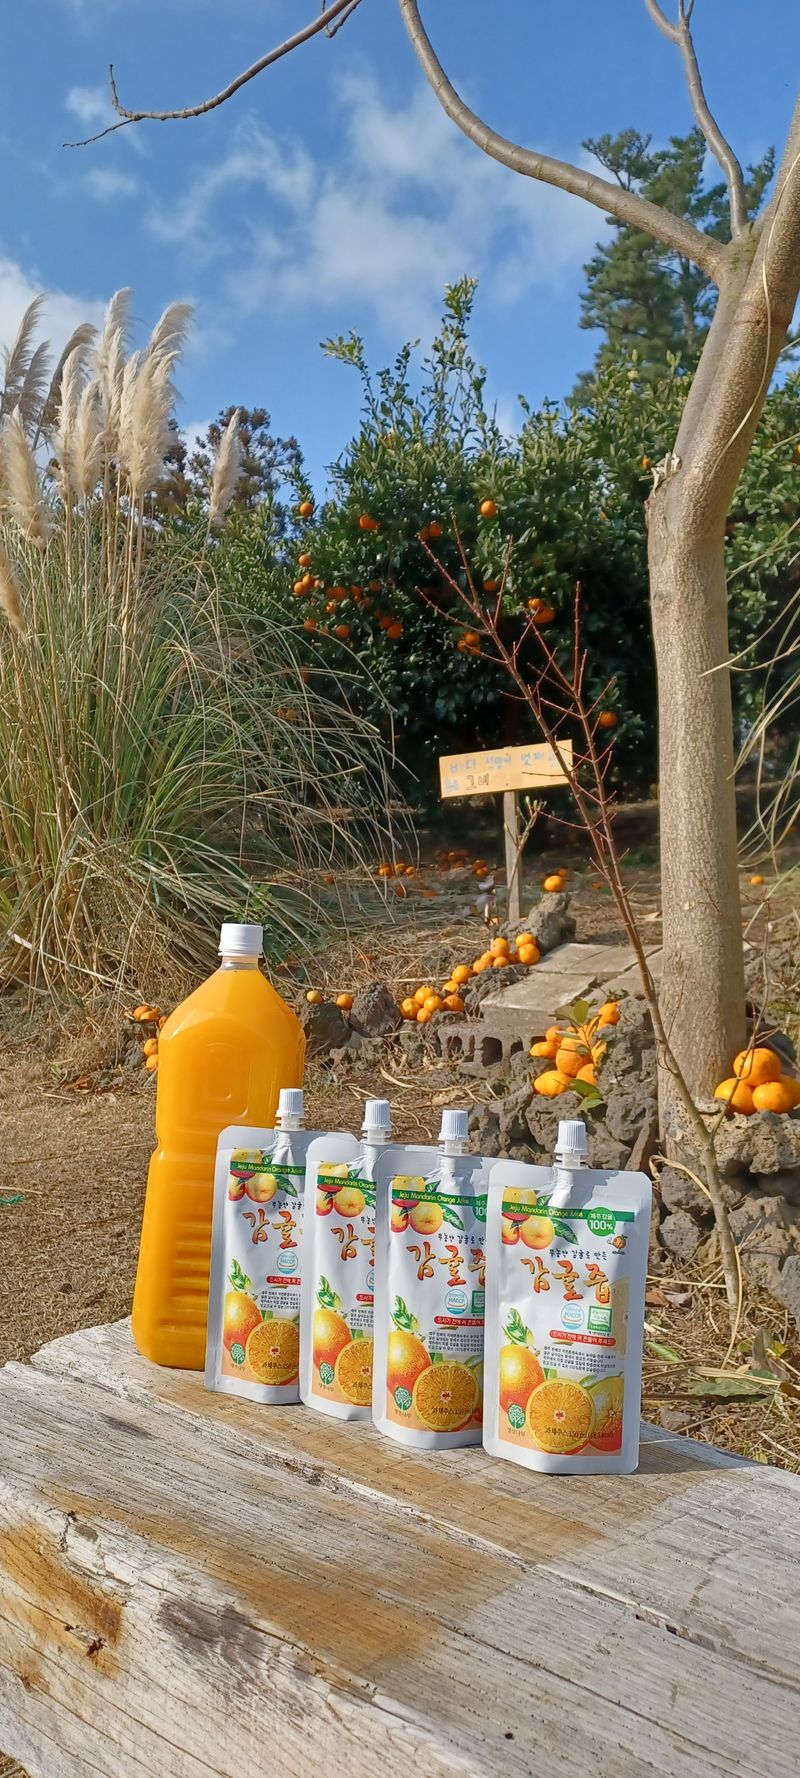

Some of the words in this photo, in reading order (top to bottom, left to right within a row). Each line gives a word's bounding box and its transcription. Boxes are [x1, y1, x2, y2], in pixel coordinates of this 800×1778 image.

[335, 1179, 358, 1187] Mandarin
[411, 1193, 436, 1201] Mandarin
[437, 1195, 456, 1203] Orange
[510, 1205, 521, 1213] Jeju
[522, 1206, 548, 1216] Mandarin
[549, 1208, 569, 1218] Orange
[570, 1210, 584, 1218] Juice
[590, 1220, 613, 1230] 100%
[549, 1248, 569, 1258] 무농약
[572, 1250, 590, 1259] 감귤로
[594, 1252, 608, 1261] 만든
[520, 1256, 611, 1304] 감귤즙
